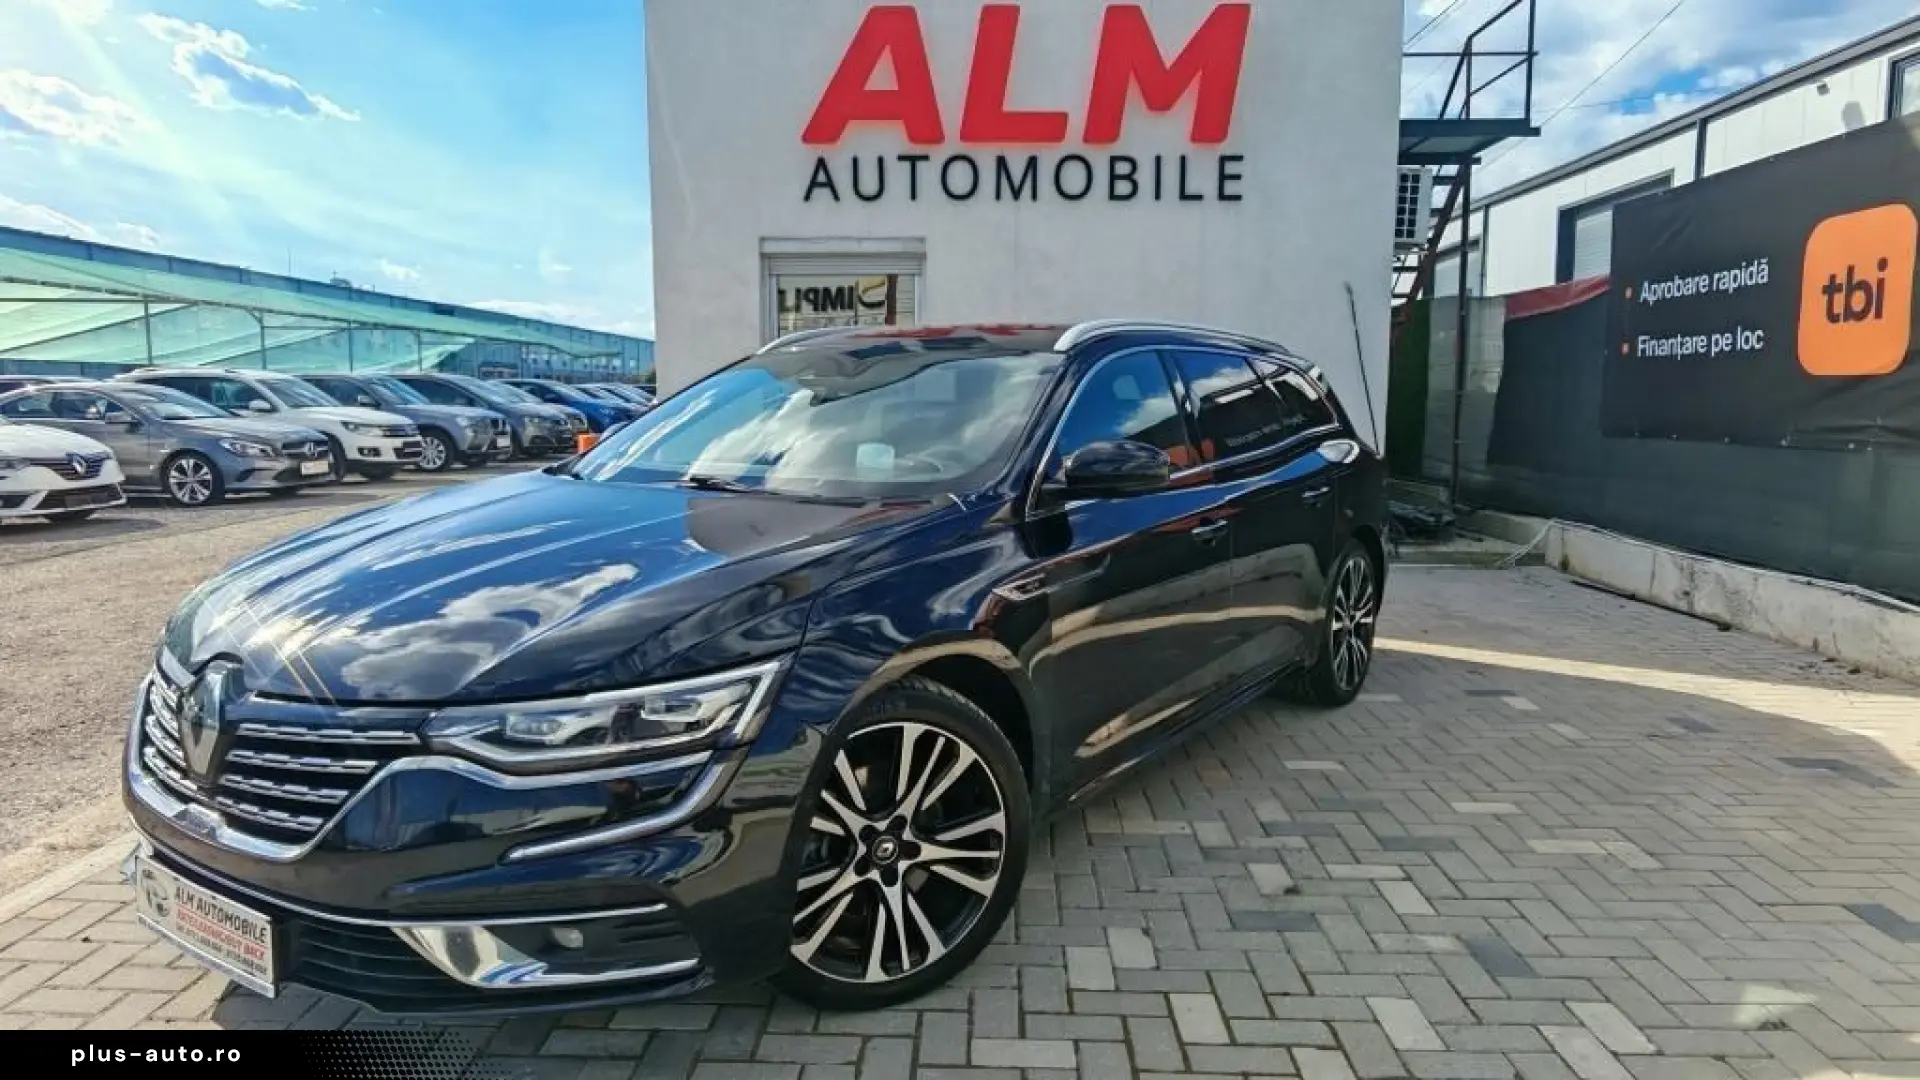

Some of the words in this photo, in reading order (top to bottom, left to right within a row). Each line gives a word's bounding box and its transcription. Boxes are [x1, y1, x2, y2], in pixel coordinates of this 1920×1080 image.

[801, 4, 1252, 145] ALM
[803, 154, 1245, 203] AUTOMOBILE
[1640, 273, 1709, 306] Aprobare
[1712, 257, 1770, 294] rapidă
[1821, 256, 1889, 325] tbi
[1637, 331, 1707, 361] Finanțare
[1711, 336, 1732, 357] pe
[1737, 325, 1765, 352] loc
[174, 886, 195, 910] ALM
[196, 897, 267, 944] AUTOMOBILE
